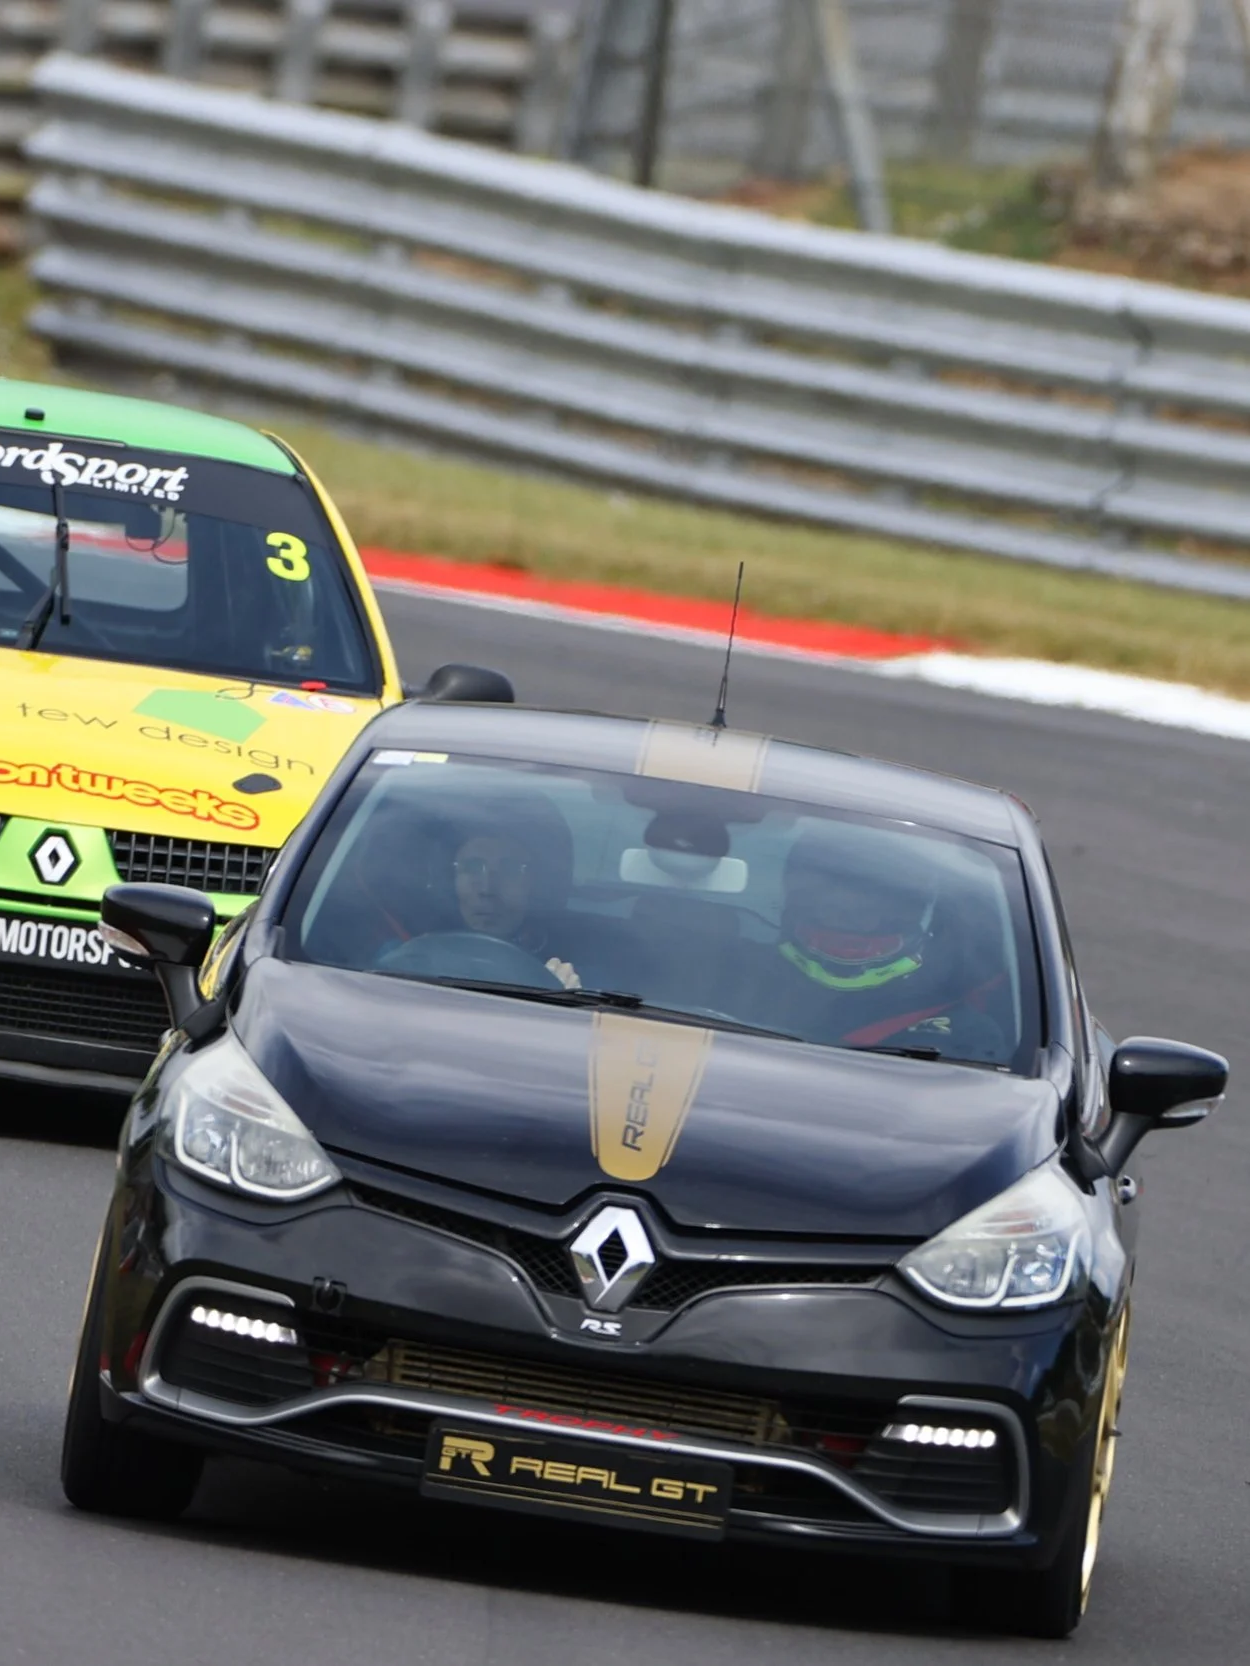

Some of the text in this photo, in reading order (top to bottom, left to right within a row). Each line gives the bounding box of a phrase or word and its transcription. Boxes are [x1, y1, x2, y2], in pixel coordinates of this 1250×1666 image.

[92, 479, 181, 501] LIMITED
[266, 532, 310, 582] 3
[17, 702, 118, 730] tew
[139, 725, 315, 776] design
[622, 1072, 655, 1152] REAL
[581, 1318, 622, 1337] RS
[494, 1403, 681, 1442] TROPHY
[510, 1456, 718, 1503] REAL GT
